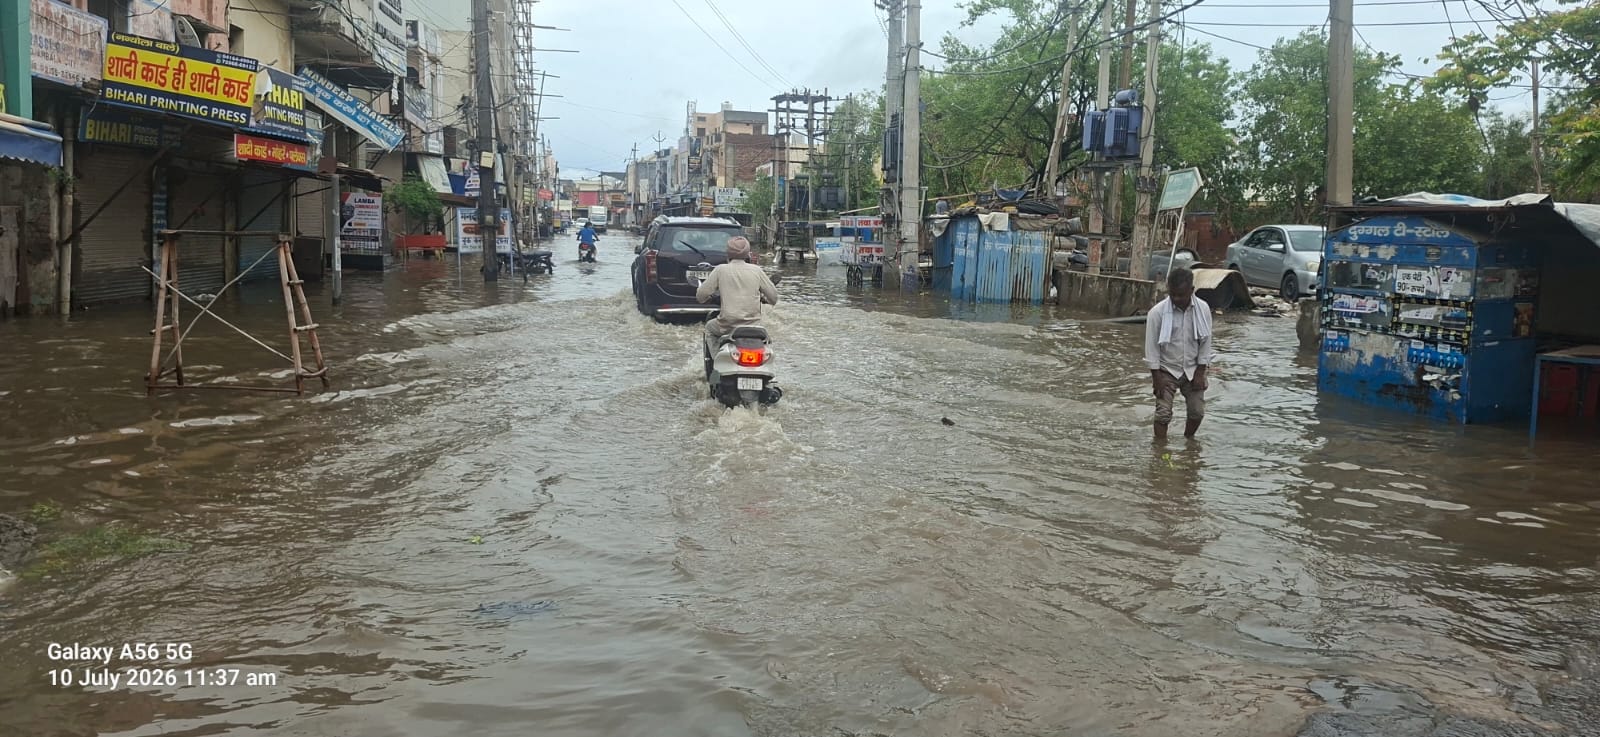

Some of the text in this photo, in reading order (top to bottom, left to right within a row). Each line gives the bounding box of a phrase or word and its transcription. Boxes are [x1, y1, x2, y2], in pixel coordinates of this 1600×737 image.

[107, 50, 139, 80] शादी
[141, 57, 170, 88] कार्ड
[172, 60, 187, 91] ही
[190, 66, 220, 96] शादी
[222, 74, 253, 103] कार्ड
[105, 87, 247, 124] BIHARI PRINTING PRESS
[261, 83, 303, 111] IHARI
[303, 66, 354, 102] MANDEEP
[356, 101, 402, 135] TRAVELS
[85, 118, 132, 144] BIHARI
[287, 110, 304, 126] PRESS
[134, 134, 159, 146] PRESS
[237, 139, 253, 156] शादी
[253, 142, 267, 159] कार्ड
[1348, 224, 1391, 241] दुग्गल
